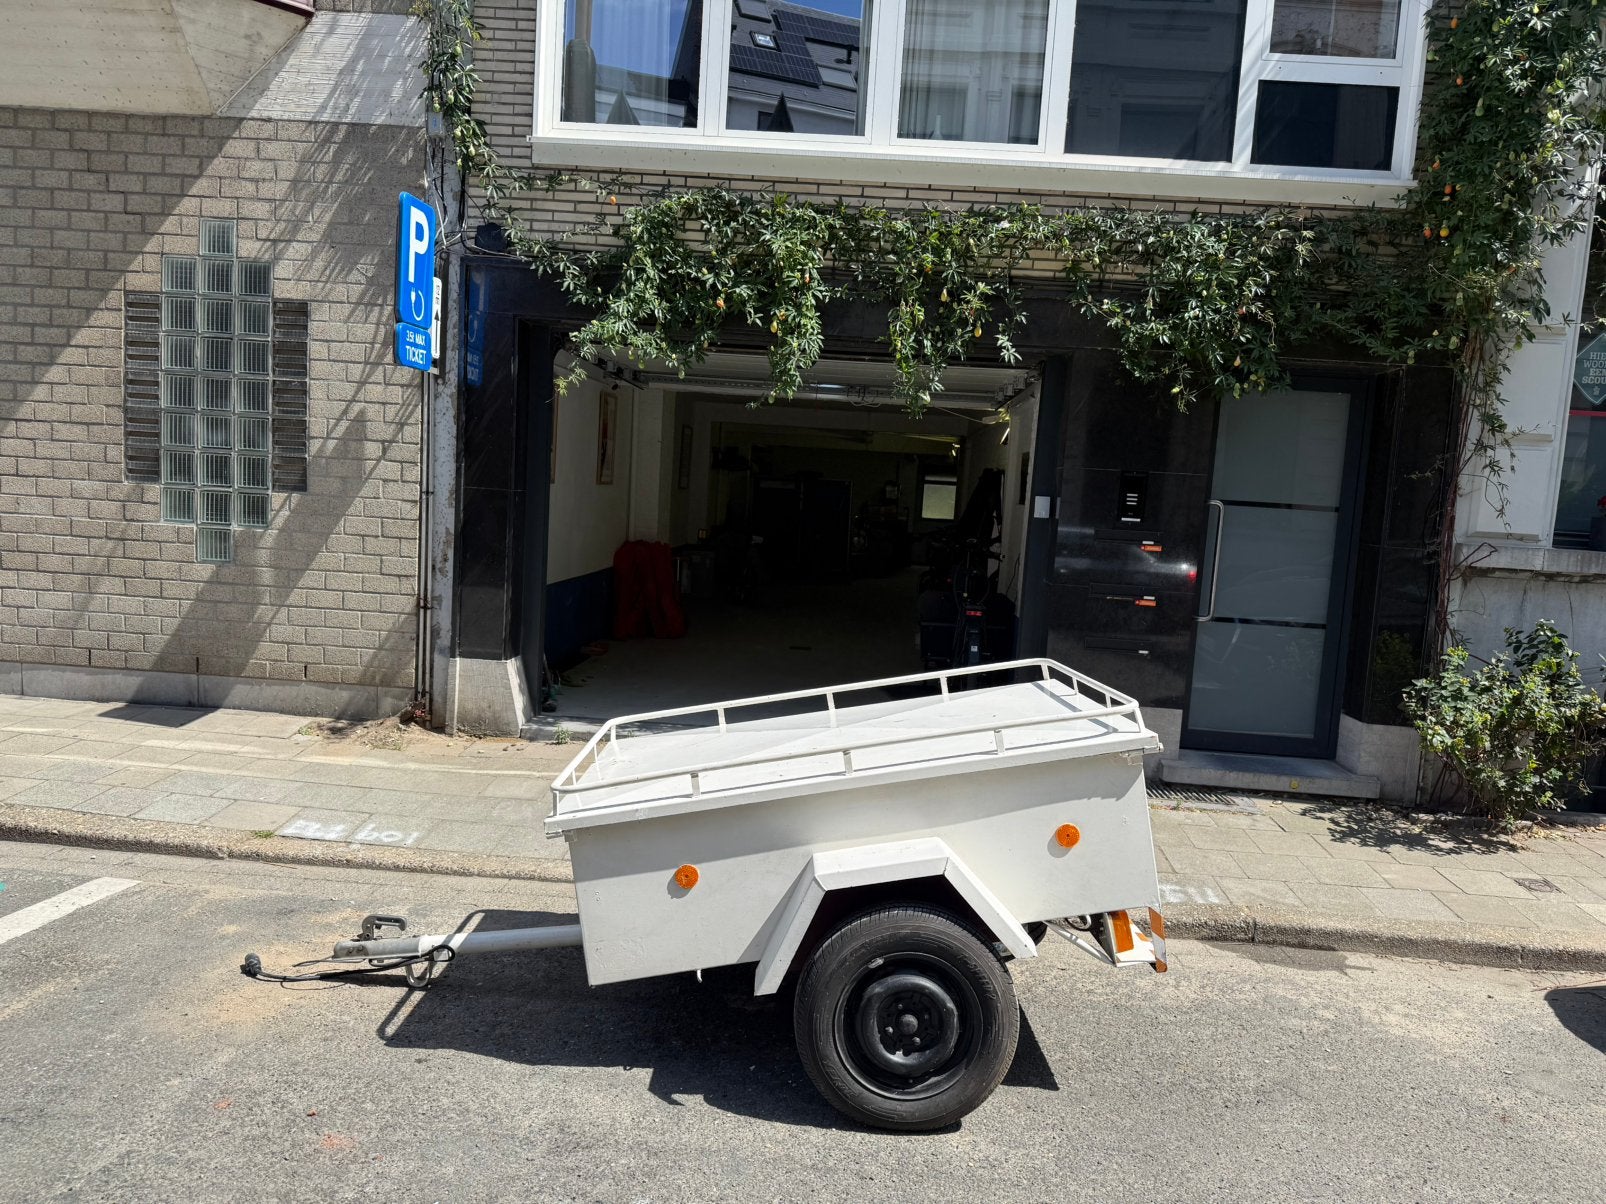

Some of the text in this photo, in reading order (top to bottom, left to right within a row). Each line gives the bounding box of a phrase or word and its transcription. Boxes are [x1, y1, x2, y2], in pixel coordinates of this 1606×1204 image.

[408, 205, 429, 283] P
[415, 333, 426, 347] MAX
[405, 345, 426, 364] TICKET
[1582, 376, 1606, 384] SCOU
